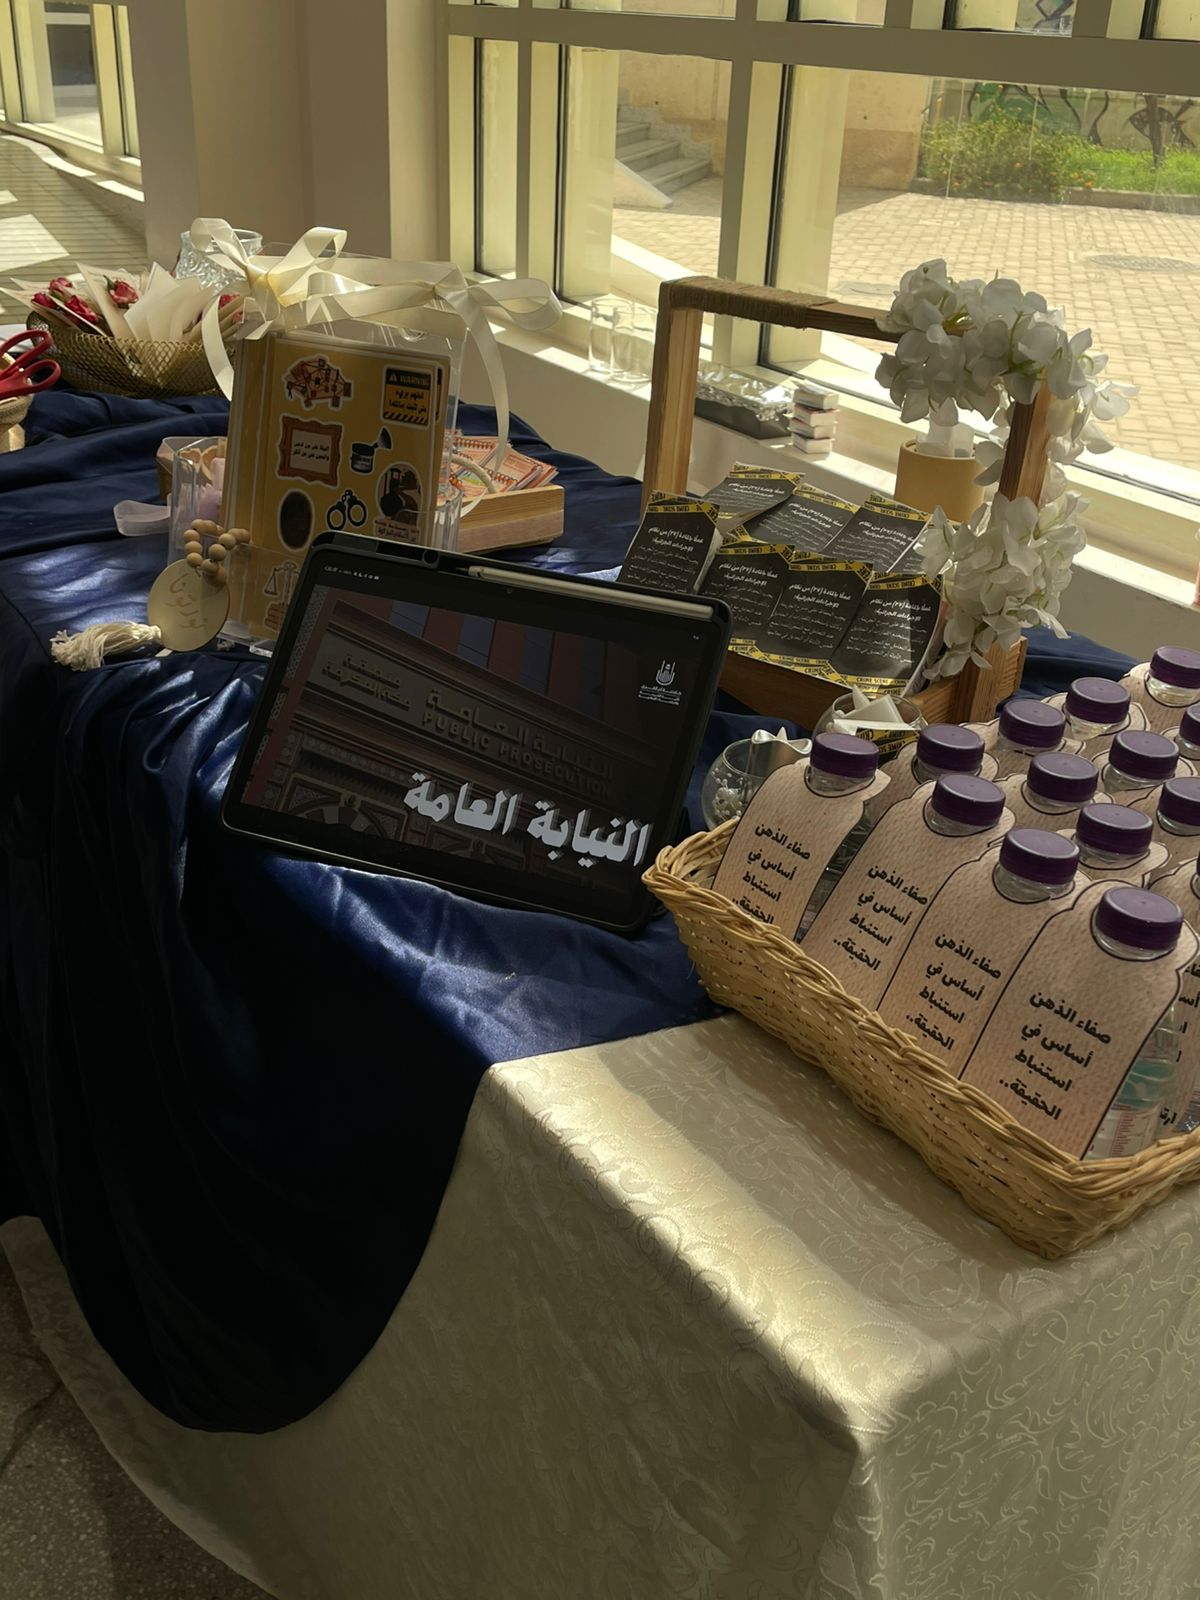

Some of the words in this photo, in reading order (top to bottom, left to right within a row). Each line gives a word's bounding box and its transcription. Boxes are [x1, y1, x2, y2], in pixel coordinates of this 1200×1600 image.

[426, 688, 529, 746] العامة
[423, 710, 491, 750] PUBLIC
[500, 741, 612, 799] PROSECUTION
[404, 772, 524, 836] العامة
[527, 800, 654, 868] النيابة
[755, 824, 787, 847] الذهن
[748, 849, 763, 864] في
[786, 841, 811, 861] صفاء
[760, 855, 797, 881] أساس
[868, 864, 903, 889] الذهن
[742, 871, 782, 902] استنباط
[858, 891, 876, 907] في
[902, 884, 929, 906] صفاء
[872, 898, 914, 927] أساس
[849, 913, 893, 947] استنباط
[935, 933, 974, 960] الذهن
[926, 961, 944, 979] في
[971, 956, 1002, 980] صفاء
[942, 971, 985, 1002] أساس
[919, 985, 965, 1024] استنباط
[1030, 991, 1077, 1024] الذهن
[1021, 1022, 1043, 1042] في
[1076, 1018, 1112, 1045] صفاء
[1040, 1033, 1094, 1068] أساس
[1014, 1049, 1073, 1092] استنباط
